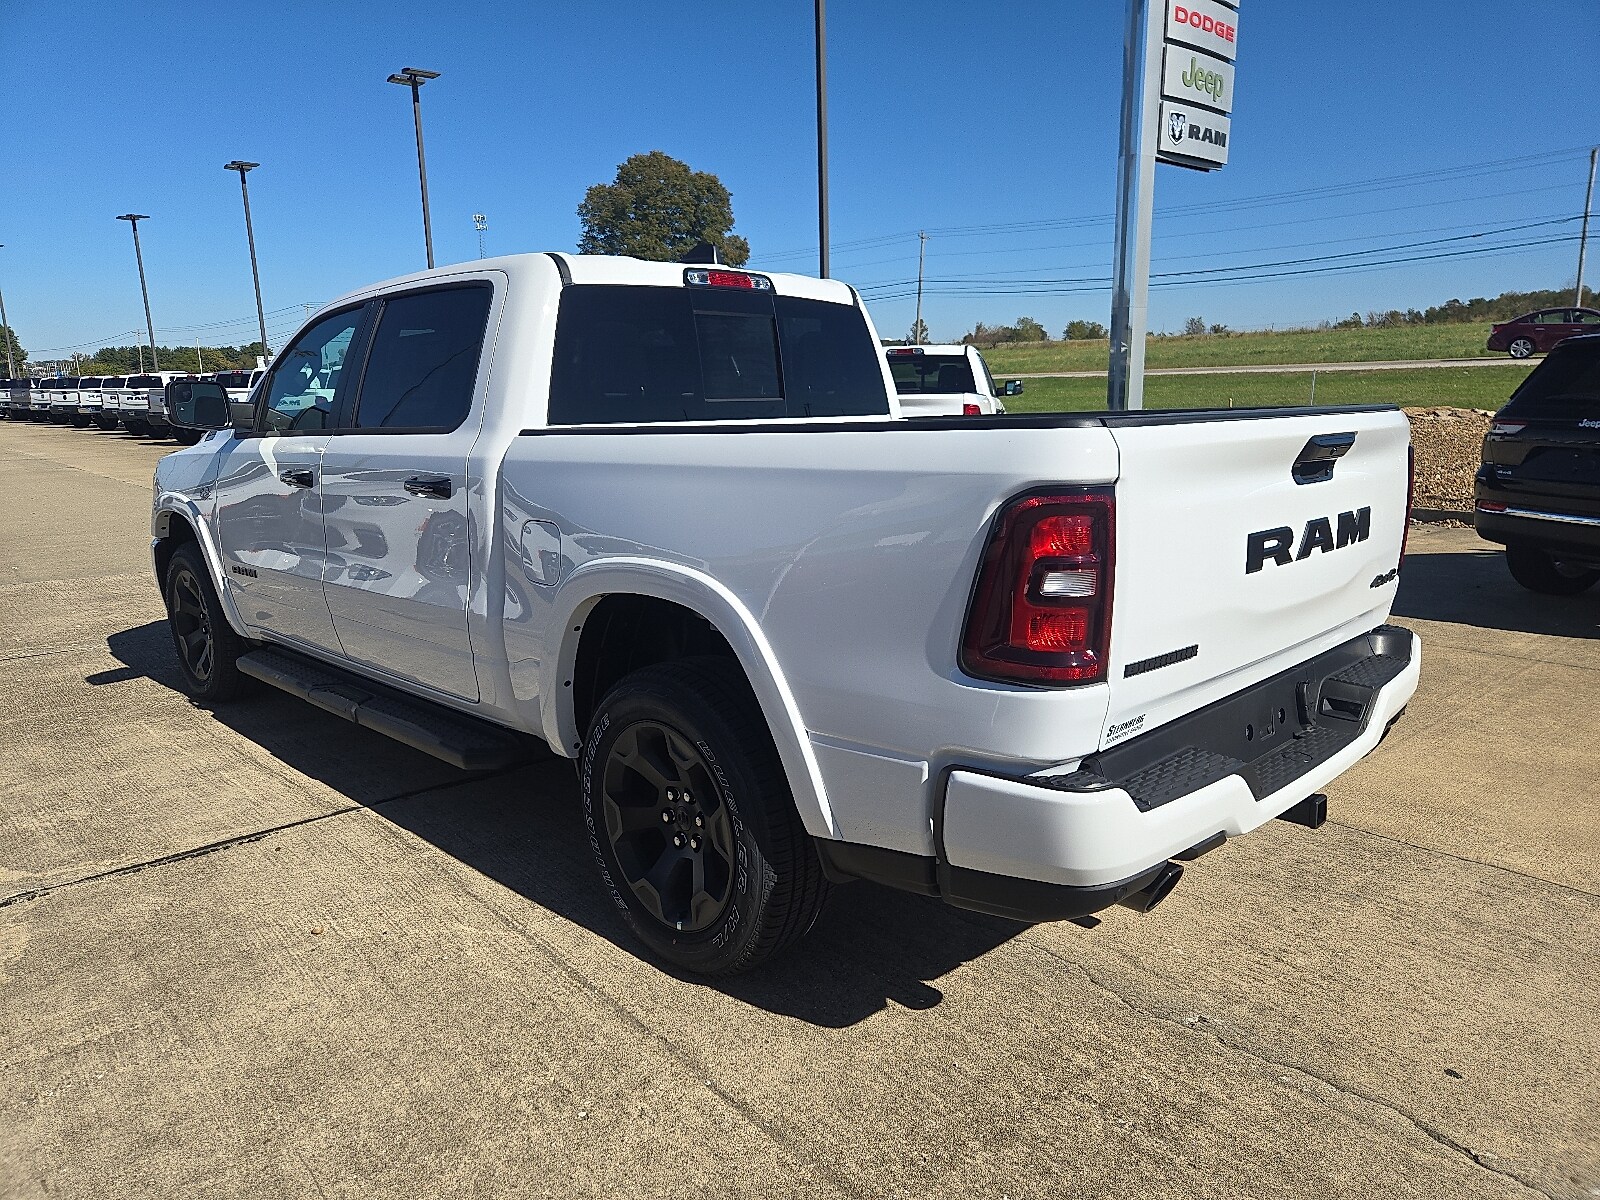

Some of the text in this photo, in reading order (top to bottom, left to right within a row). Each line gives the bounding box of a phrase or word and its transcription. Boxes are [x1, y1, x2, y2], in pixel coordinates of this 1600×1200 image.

[1174, 5, 1235, 43] DODGE
[1182, 57, 1224, 102] Jeep
[1188, 123, 1227, 148] RAM
[1578, 418, 1600, 429] Jeep
[1246, 505, 1371, 575] RAM
